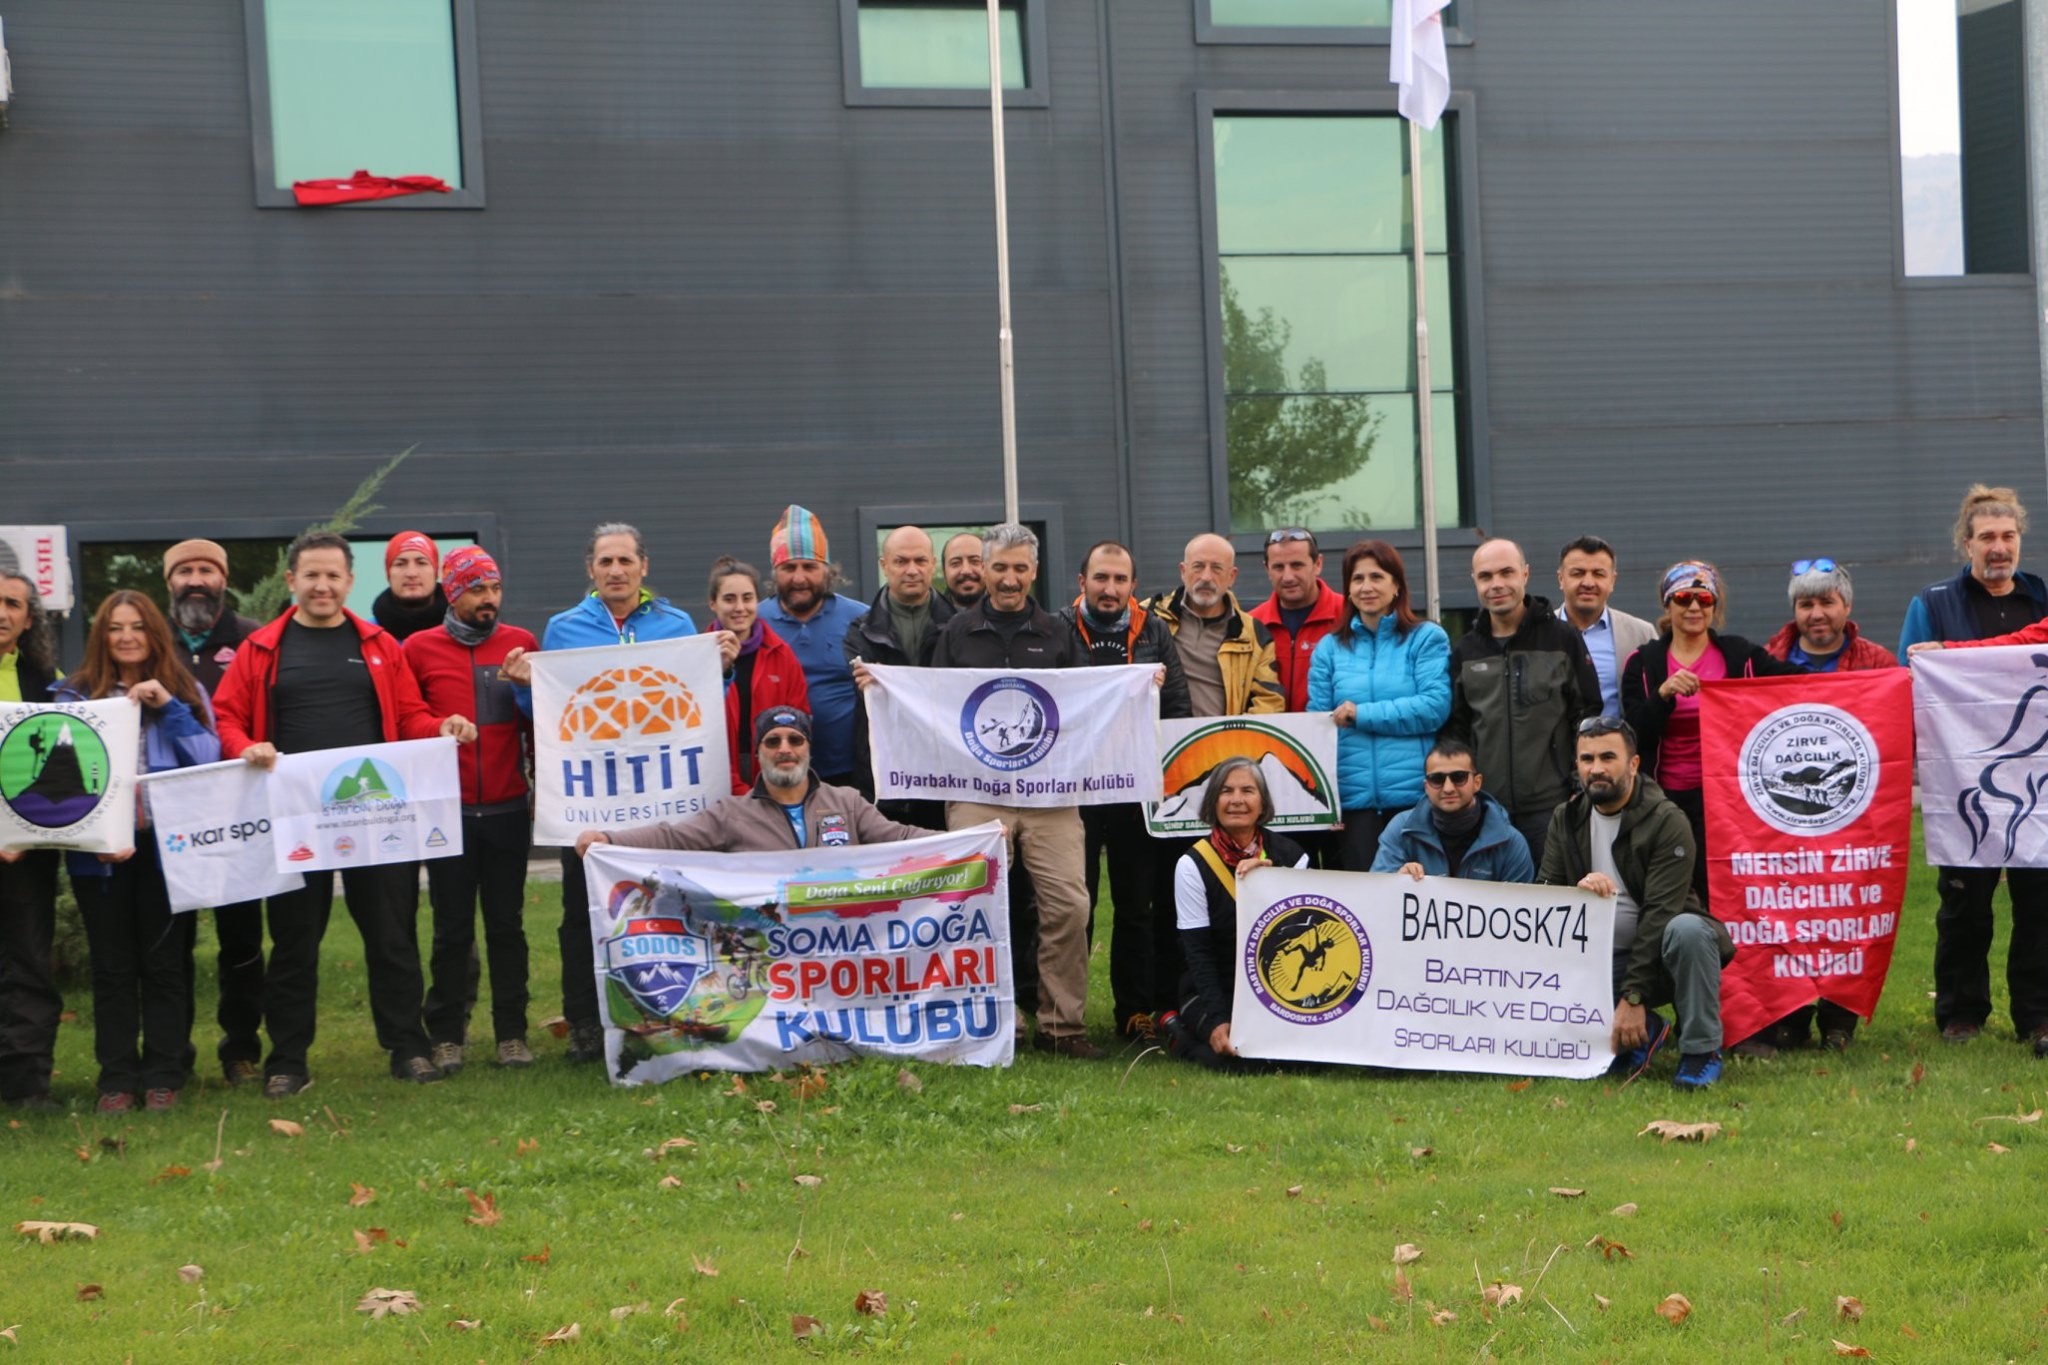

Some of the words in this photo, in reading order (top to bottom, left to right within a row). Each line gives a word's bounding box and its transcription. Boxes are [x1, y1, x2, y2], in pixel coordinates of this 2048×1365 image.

[37, 535, 53, 596] VESTEL
[1778, 719, 1791, 729] VE
[1794, 714, 1820, 723] DOĞA
[1824, 718, 1861, 751] SPORLARI
[1787, 736, 1828, 747] ZİRVE
[562, 744, 703, 798] HİTİT
[1775, 751, 1841, 763] DAĞCILIK
[890, 771, 968, 789] Diyarbakır
[973, 777, 1011, 796] Doğa
[1016, 778, 1077, 796] Sporları
[1083, 774, 1135, 792] Kulübü
[564, 798, 707, 823] ÜNİVERSİTESİ
[230, 818, 271, 841] spo
[1731, 846, 1824, 875] MERSİN
[1830, 843, 1892, 873] ZİRVE
[854, 882, 886, 895] Seni
[891, 869, 969, 895] Çağırıyor!
[1745, 881, 1853, 910] DAĞCILIK
[1859, 883, 1881, 903] ve
[1289, 897, 1303, 906] VE
[1305, 897, 1333, 909] DOĞA
[767, 923, 880, 958] SOMA
[888, 905, 992, 950] DOĞA
[1251, 904, 1287, 939] DAĞCILIK
[1402, 892, 1588, 954] BARDOSK74
[1725, 917, 1788, 944] DOĞA
[1794, 911, 1894, 942] SPORLARI
[622, 936, 696, 957] SODOS
[1247, 941, 1256, 954] 74
[767, 946, 996, 1001] SPORLARI
[1425, 959, 1561, 991] BARTIN74
[1773, 948, 1863, 977] KULÜBÜ
[775, 986, 1000, 1052] KULÜBÜ
[1270, 1002, 1317, 1022] BARDOSK74
[1377, 989, 1487, 1018] DAĞCILIK
[1493, 1001, 1525, 1020] VE
[1530, 1001, 1604, 1025] DOĞA
[1394, 1028, 1495, 1055] SPORLARI
[1505, 1037, 1591, 1060] KULÜBÜ
